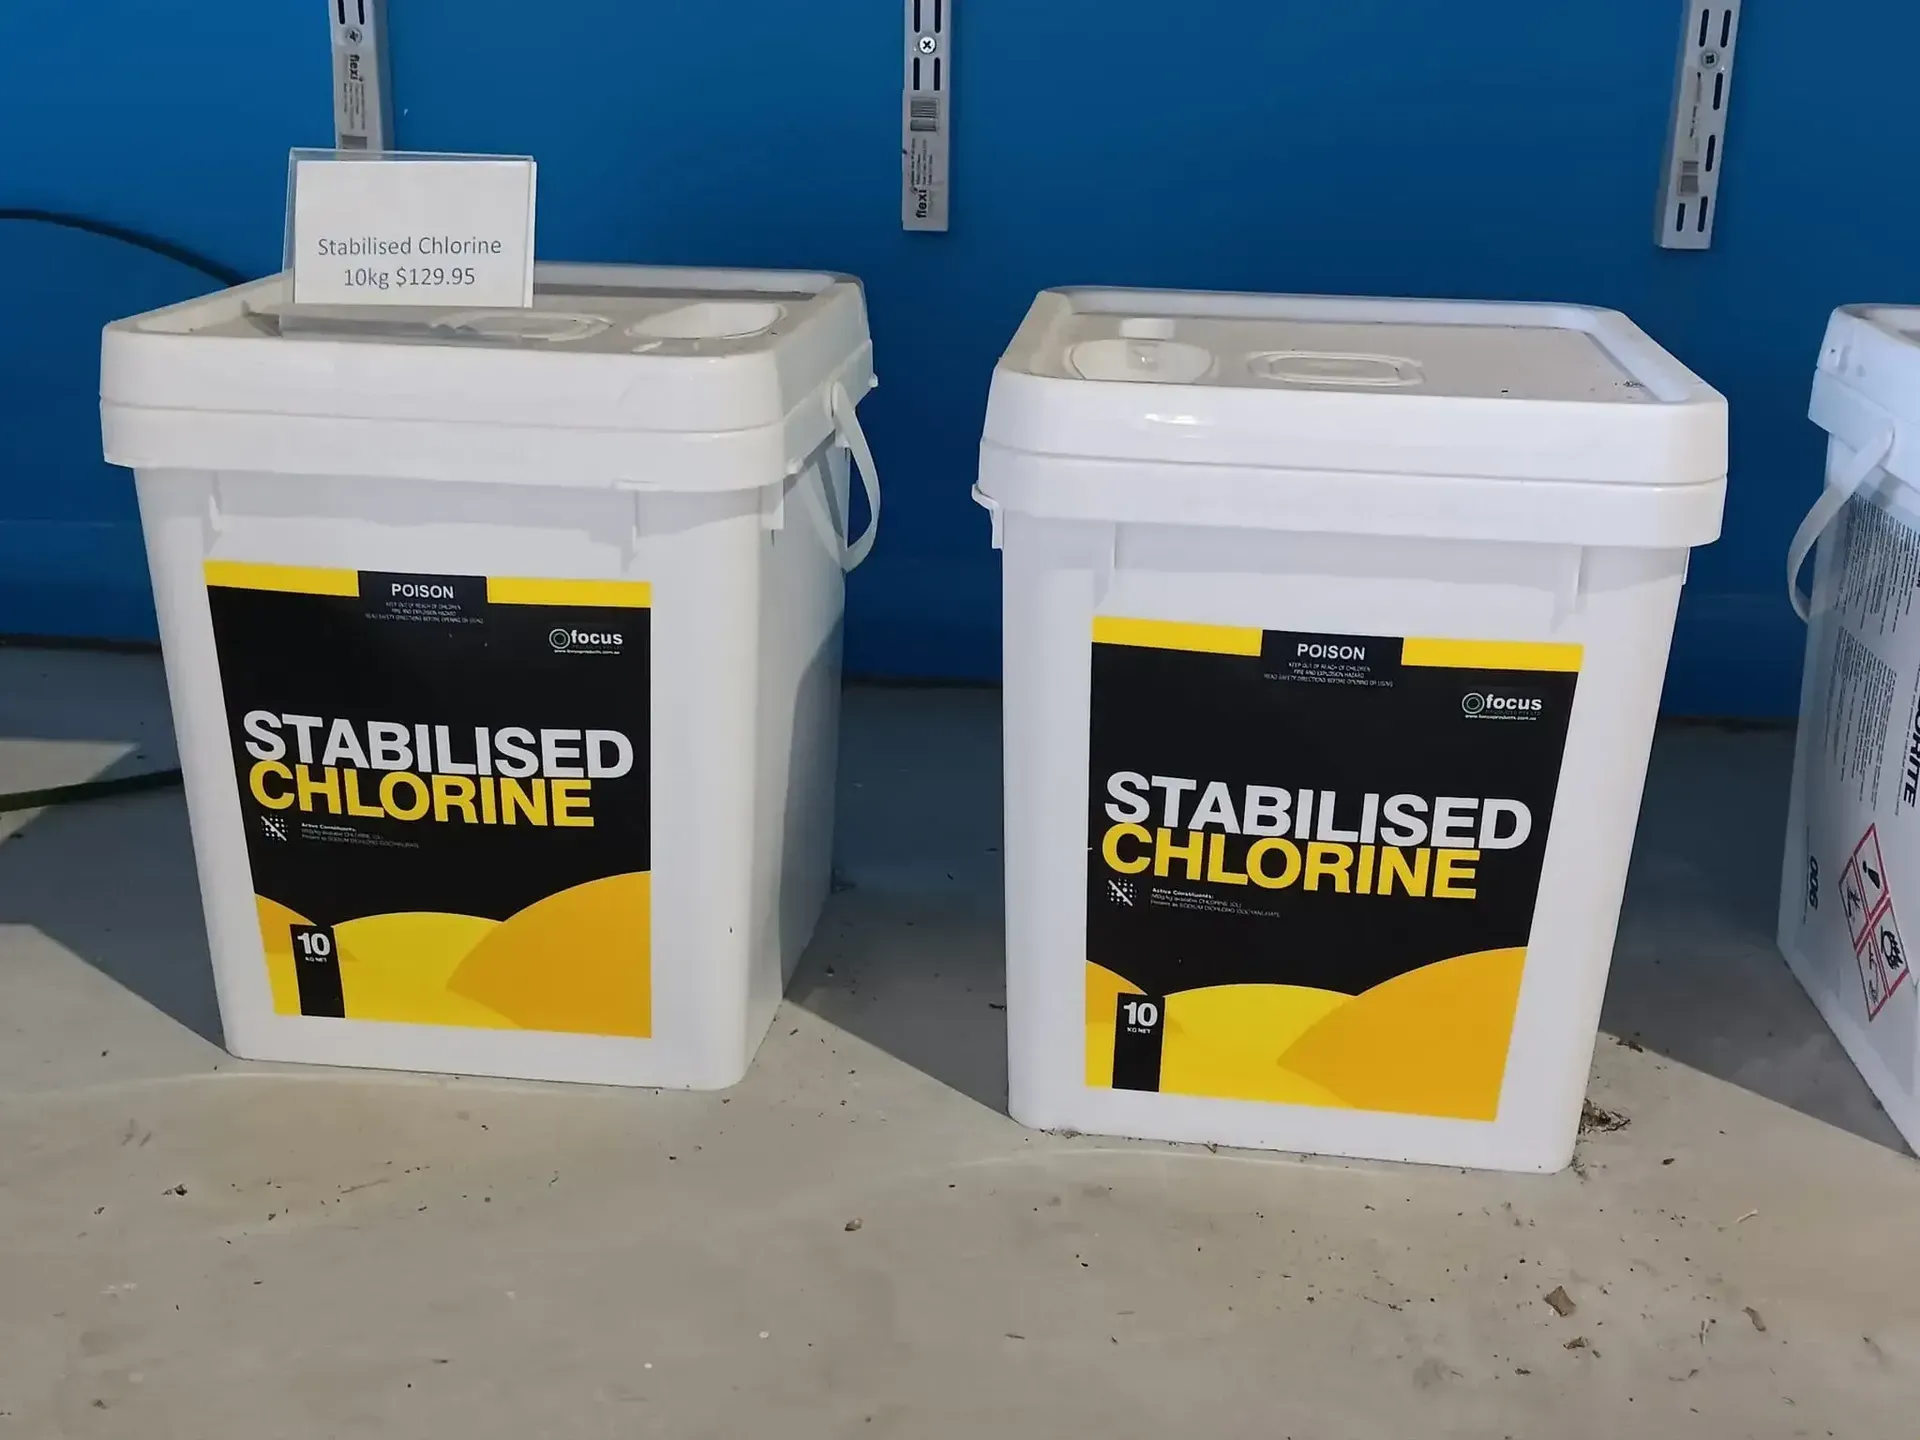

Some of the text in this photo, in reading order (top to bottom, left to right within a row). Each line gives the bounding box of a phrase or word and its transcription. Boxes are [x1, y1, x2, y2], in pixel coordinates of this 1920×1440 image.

[318, 236, 502, 255] Stabilised Chlorine
[344, 266, 475, 290] 10kg $129.95
[391, 583, 454, 599] POISON
[571, 629, 623, 645] focus
[1297, 643, 1366, 660] POISON
[1485, 693, 1542, 710] focus
[243, 710, 634, 779] STABILISED
[249, 760, 595, 827] CHLORINE
[1104, 771, 1532, 850] STABILISED
[1102, 822, 1481, 899] CHLORINE
[297, 932, 331, 956] 10
[1123, 1001, 1158, 1027] 10
